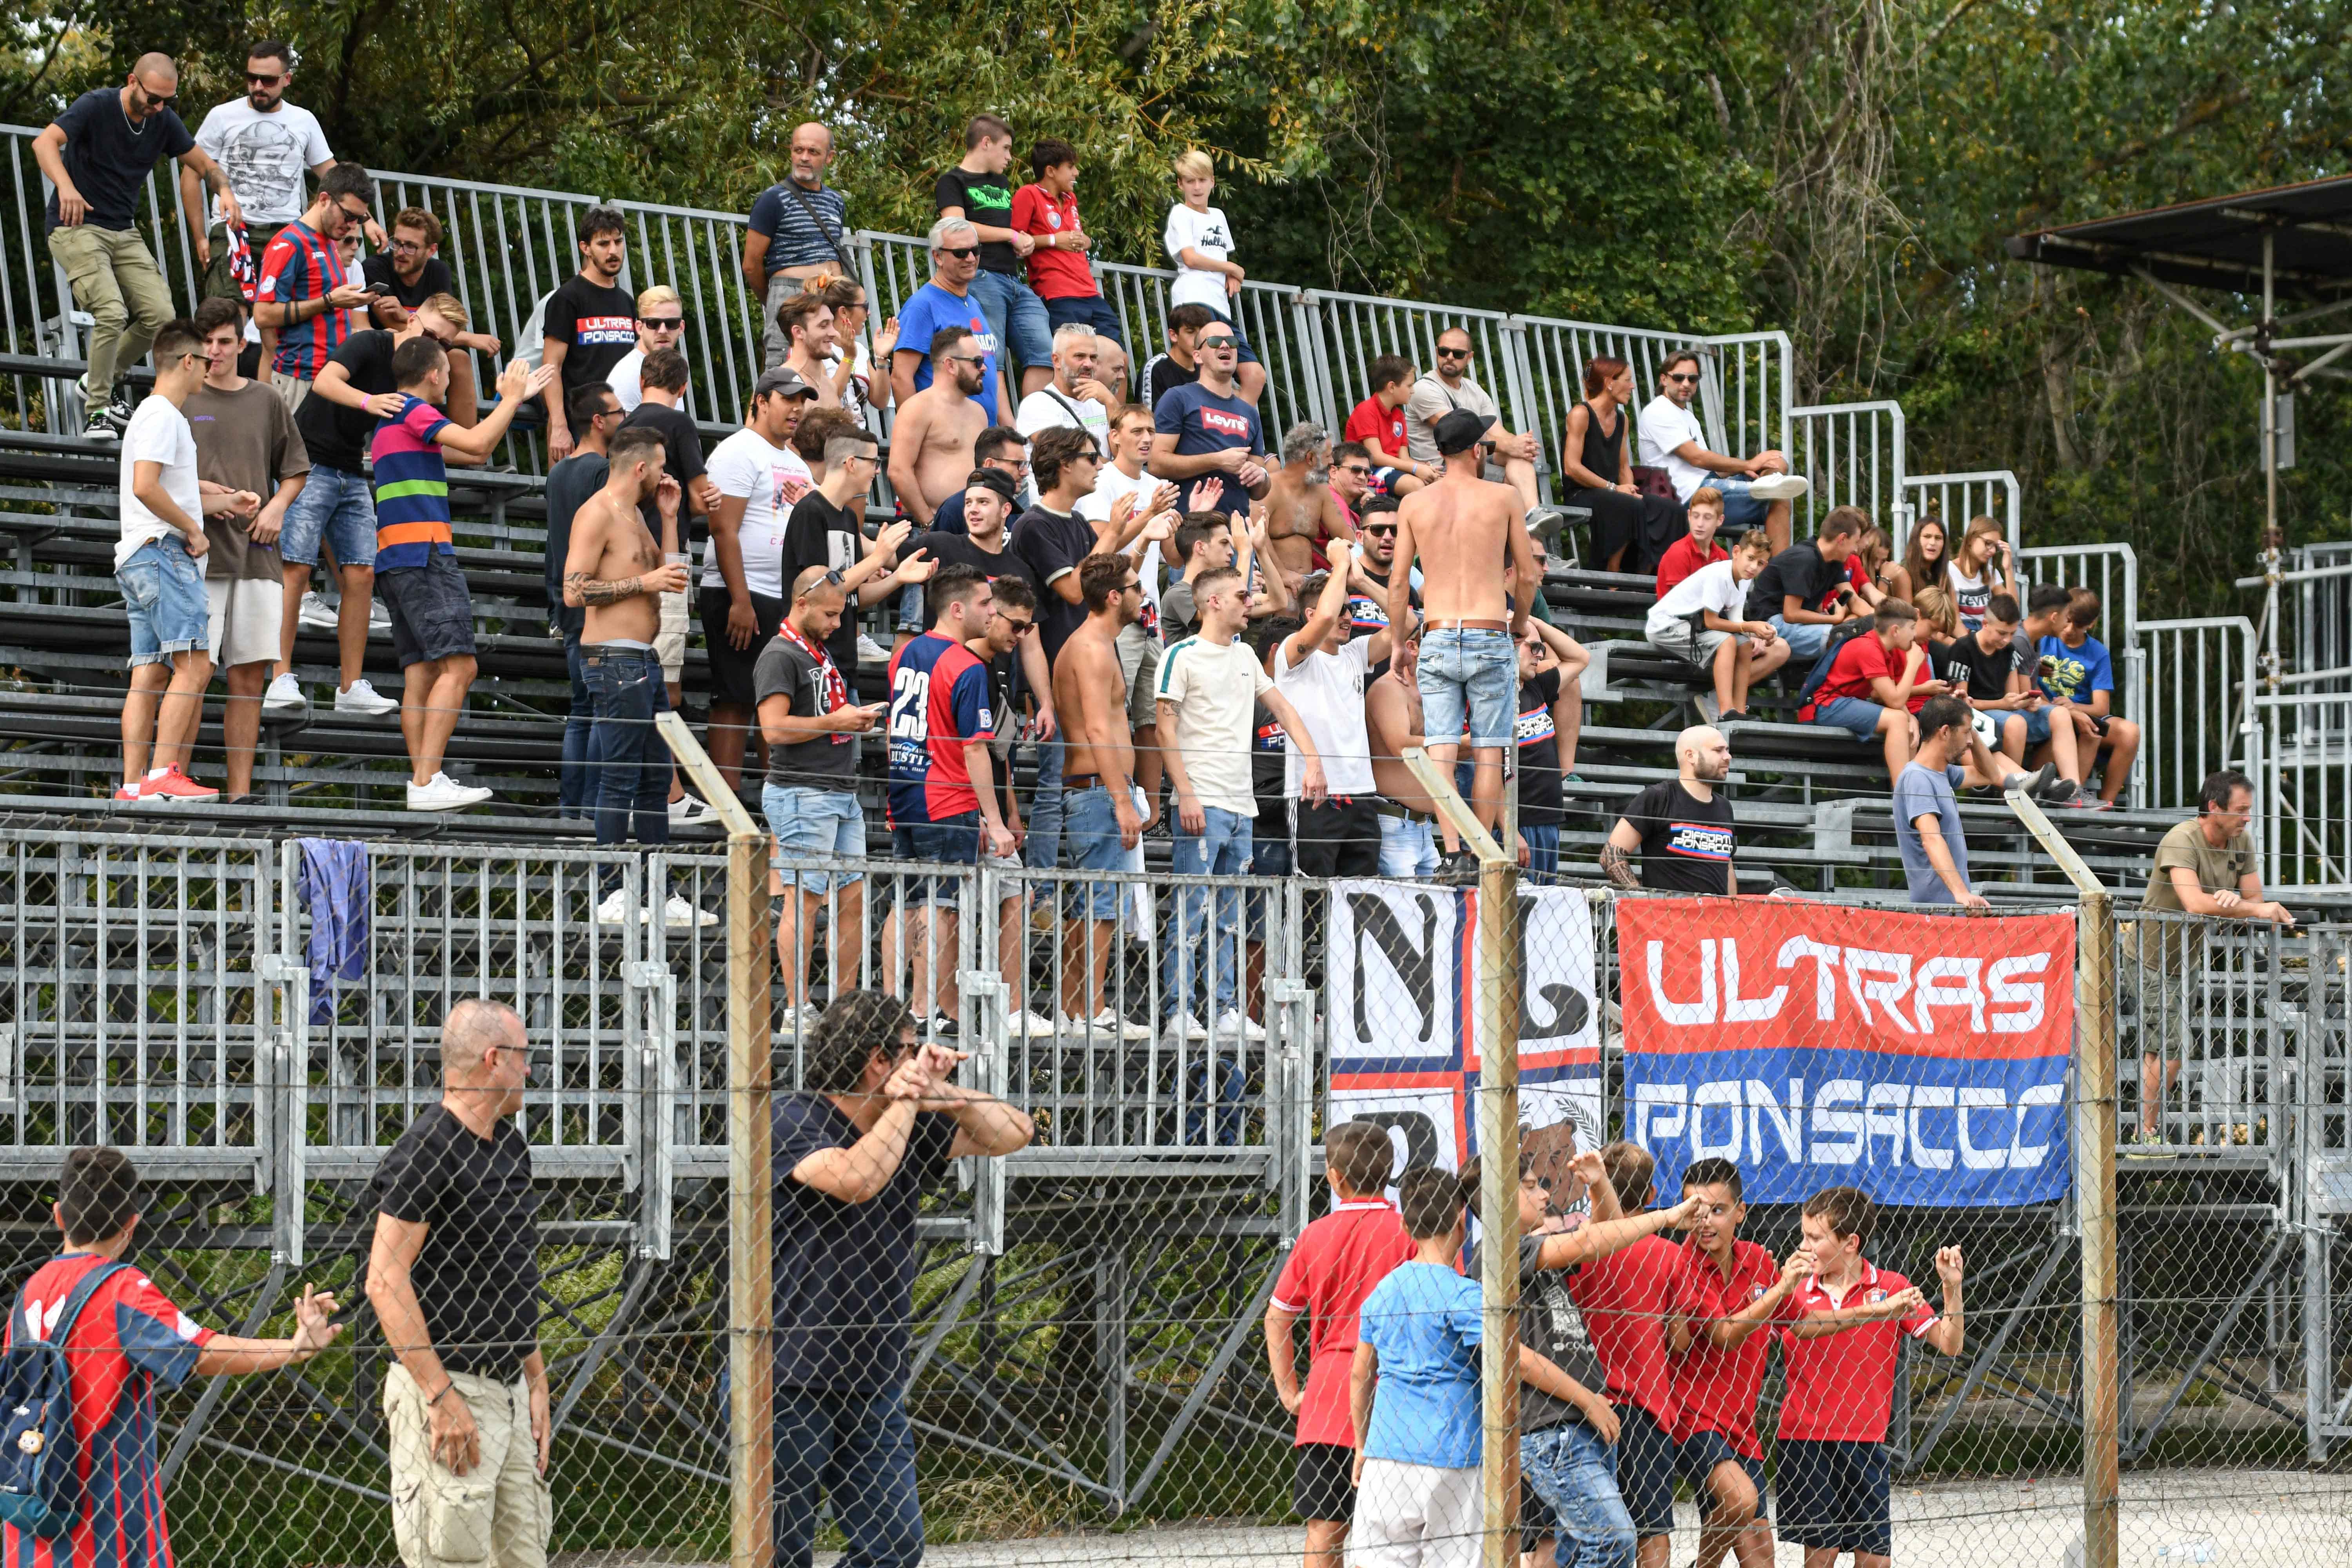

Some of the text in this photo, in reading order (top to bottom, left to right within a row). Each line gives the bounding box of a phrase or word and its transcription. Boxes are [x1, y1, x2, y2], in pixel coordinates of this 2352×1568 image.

[584, 330, 635, 343] PONSACCO
[586, 318, 632, 329] ULTRAS
[891, 667, 930, 741] 23
[1672, 837, 1733, 854] PONSACCO
[1346, 892, 1438, 1044] N
[1646, 934, 2051, 1034] ULTRAS
[1635, 1077, 2065, 1171] PONSACCO
